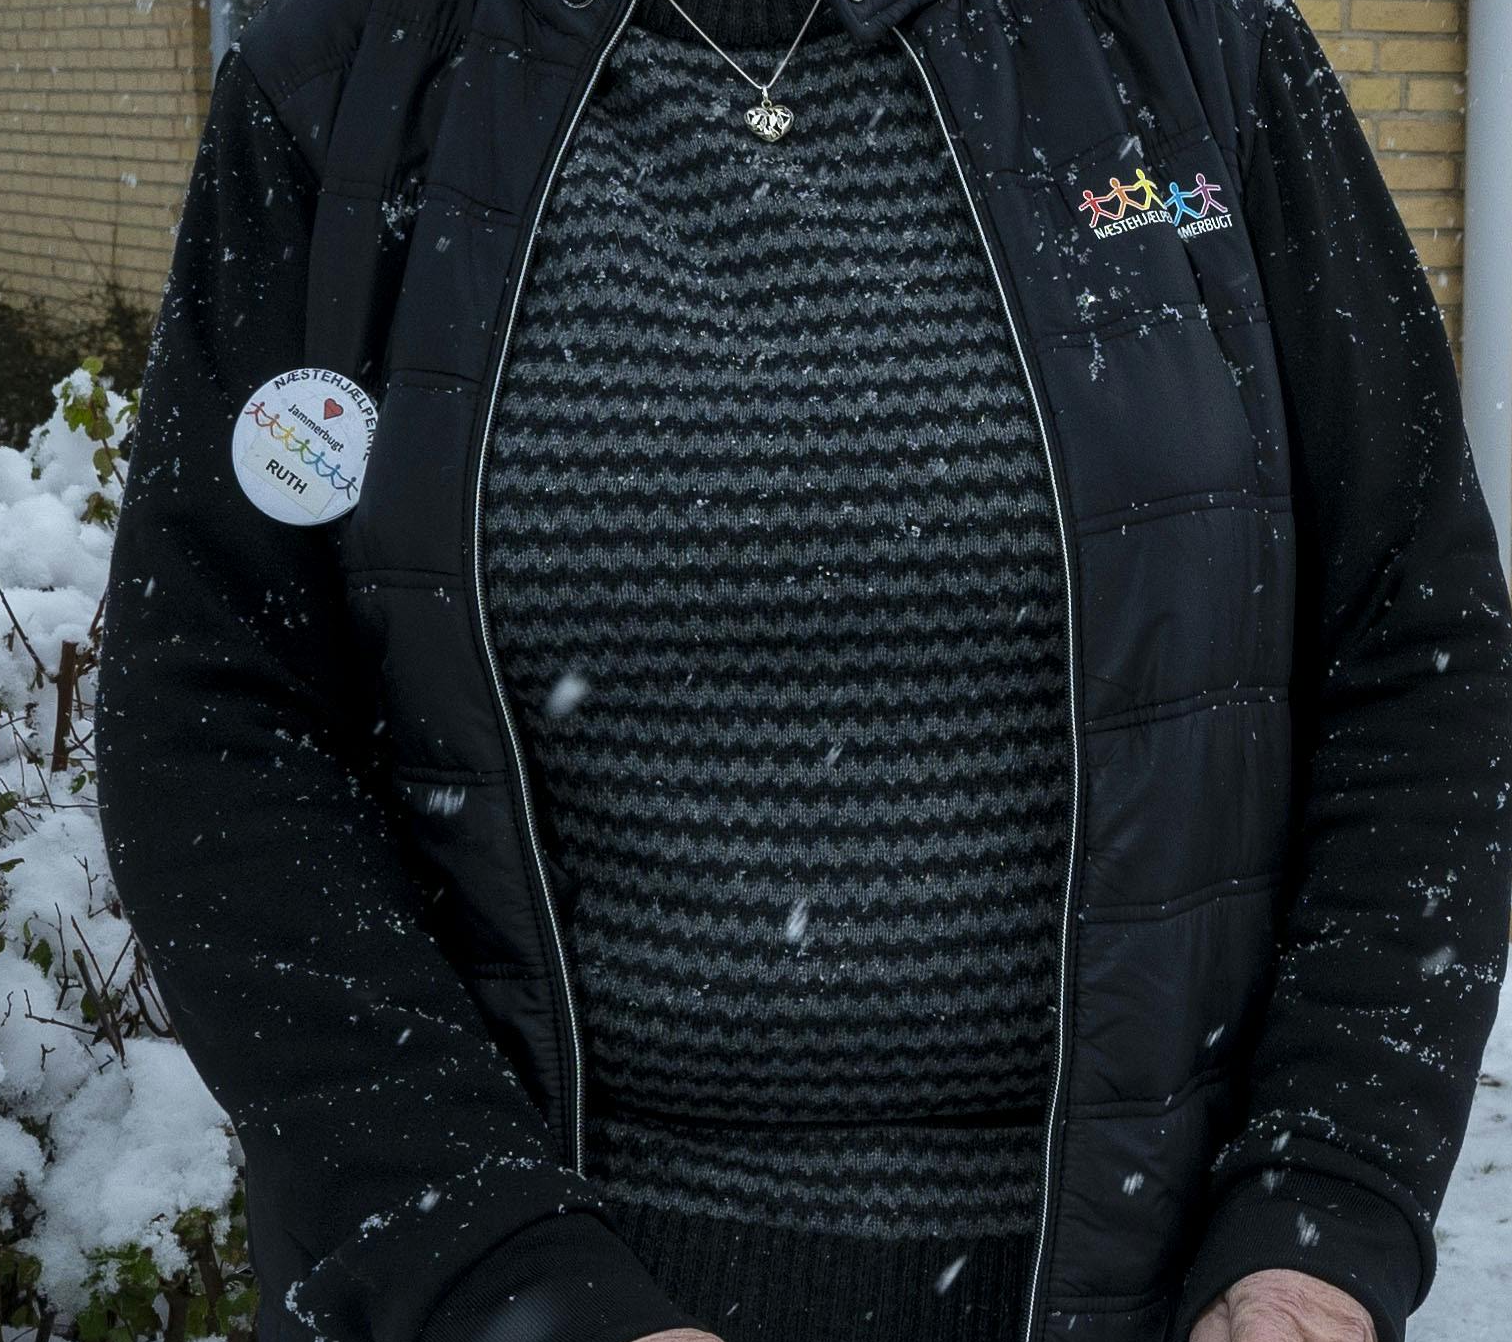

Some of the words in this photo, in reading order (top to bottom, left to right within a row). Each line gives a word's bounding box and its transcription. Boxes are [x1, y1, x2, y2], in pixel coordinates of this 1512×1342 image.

[1093, 210, 1174, 241] NÆSTEHJÆLP
[1177, 214, 1233, 239] MERBUGT
[288, 403, 345, 453] Jammerbugt
[266, 459, 308, 495] RUTH
